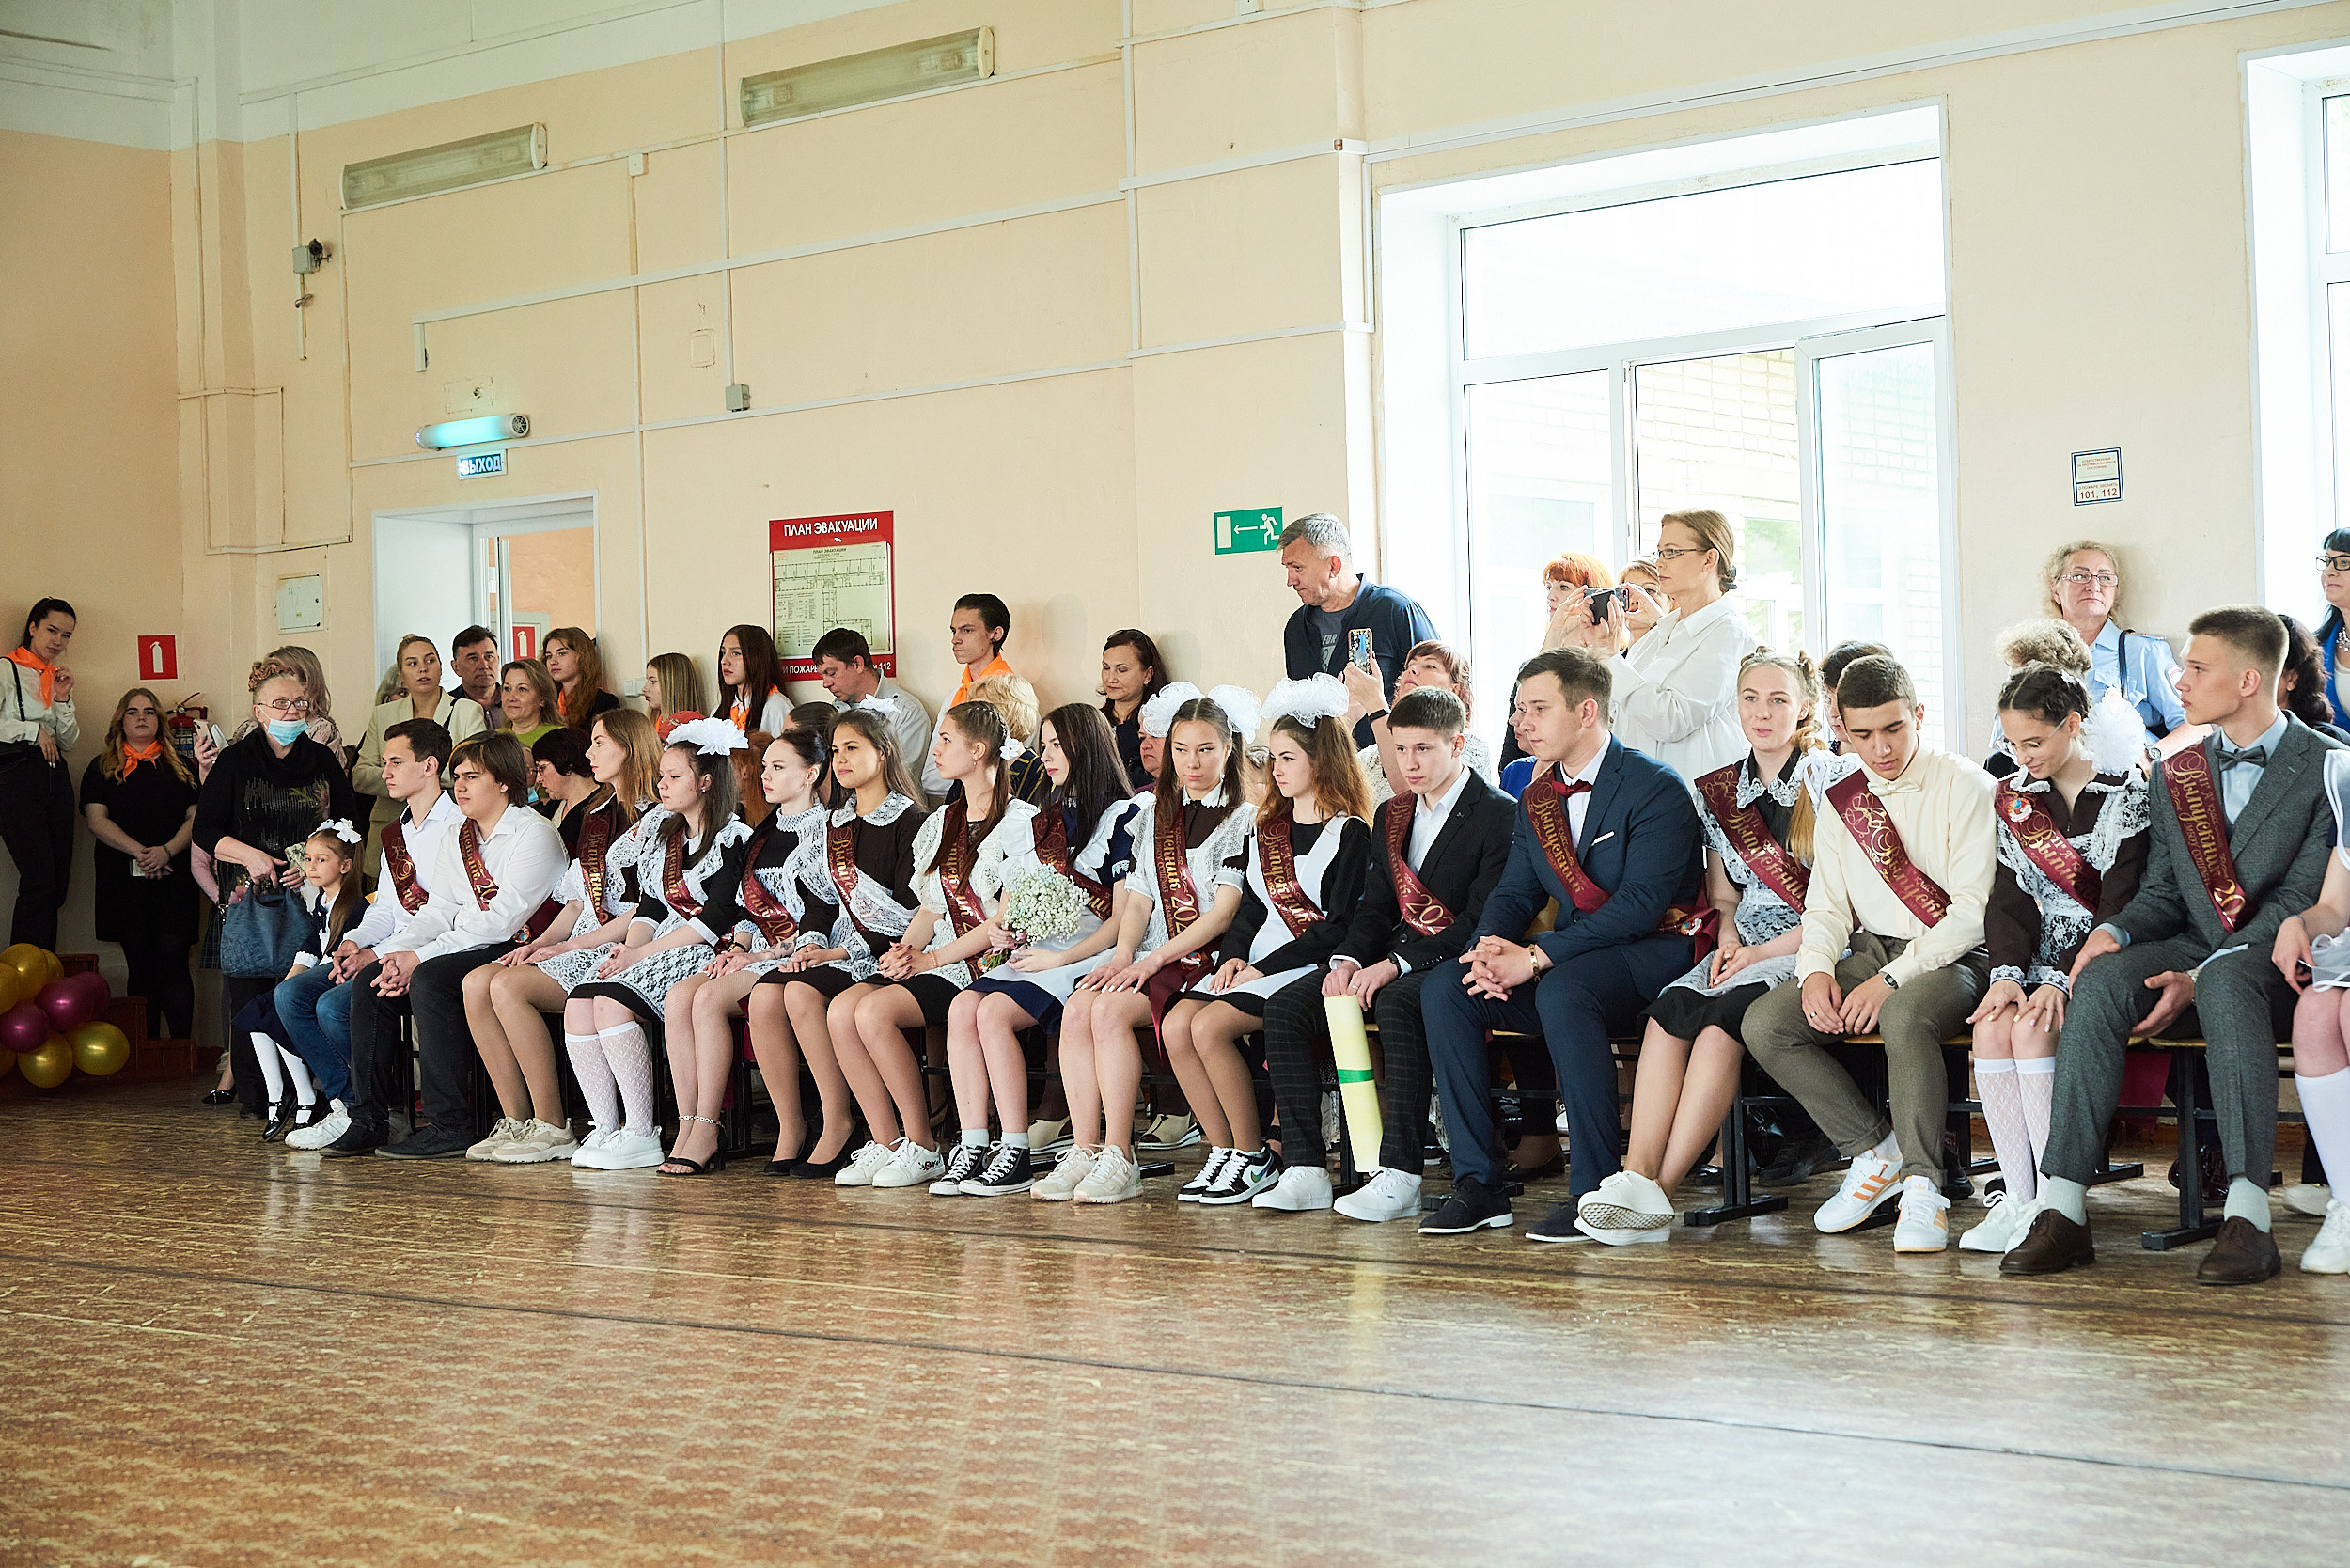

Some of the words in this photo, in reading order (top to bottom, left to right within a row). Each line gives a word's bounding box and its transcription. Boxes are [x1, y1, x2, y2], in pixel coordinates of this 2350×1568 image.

[460, 455, 502, 476] ВЫХОД
[2079, 491, 2098, 500] 101,
[2102, 488, 2117, 497] 112
[784, 523, 812, 537] ПЛАН
[813, 518, 878, 534] ЭВАКУАЦИИ
[1322, 634, 1338, 645] FOR
[878, 662, 891, 670] 112
[1534, 779, 1584, 893] Выпускник
[1264, 818, 1311, 925] Выпускник
